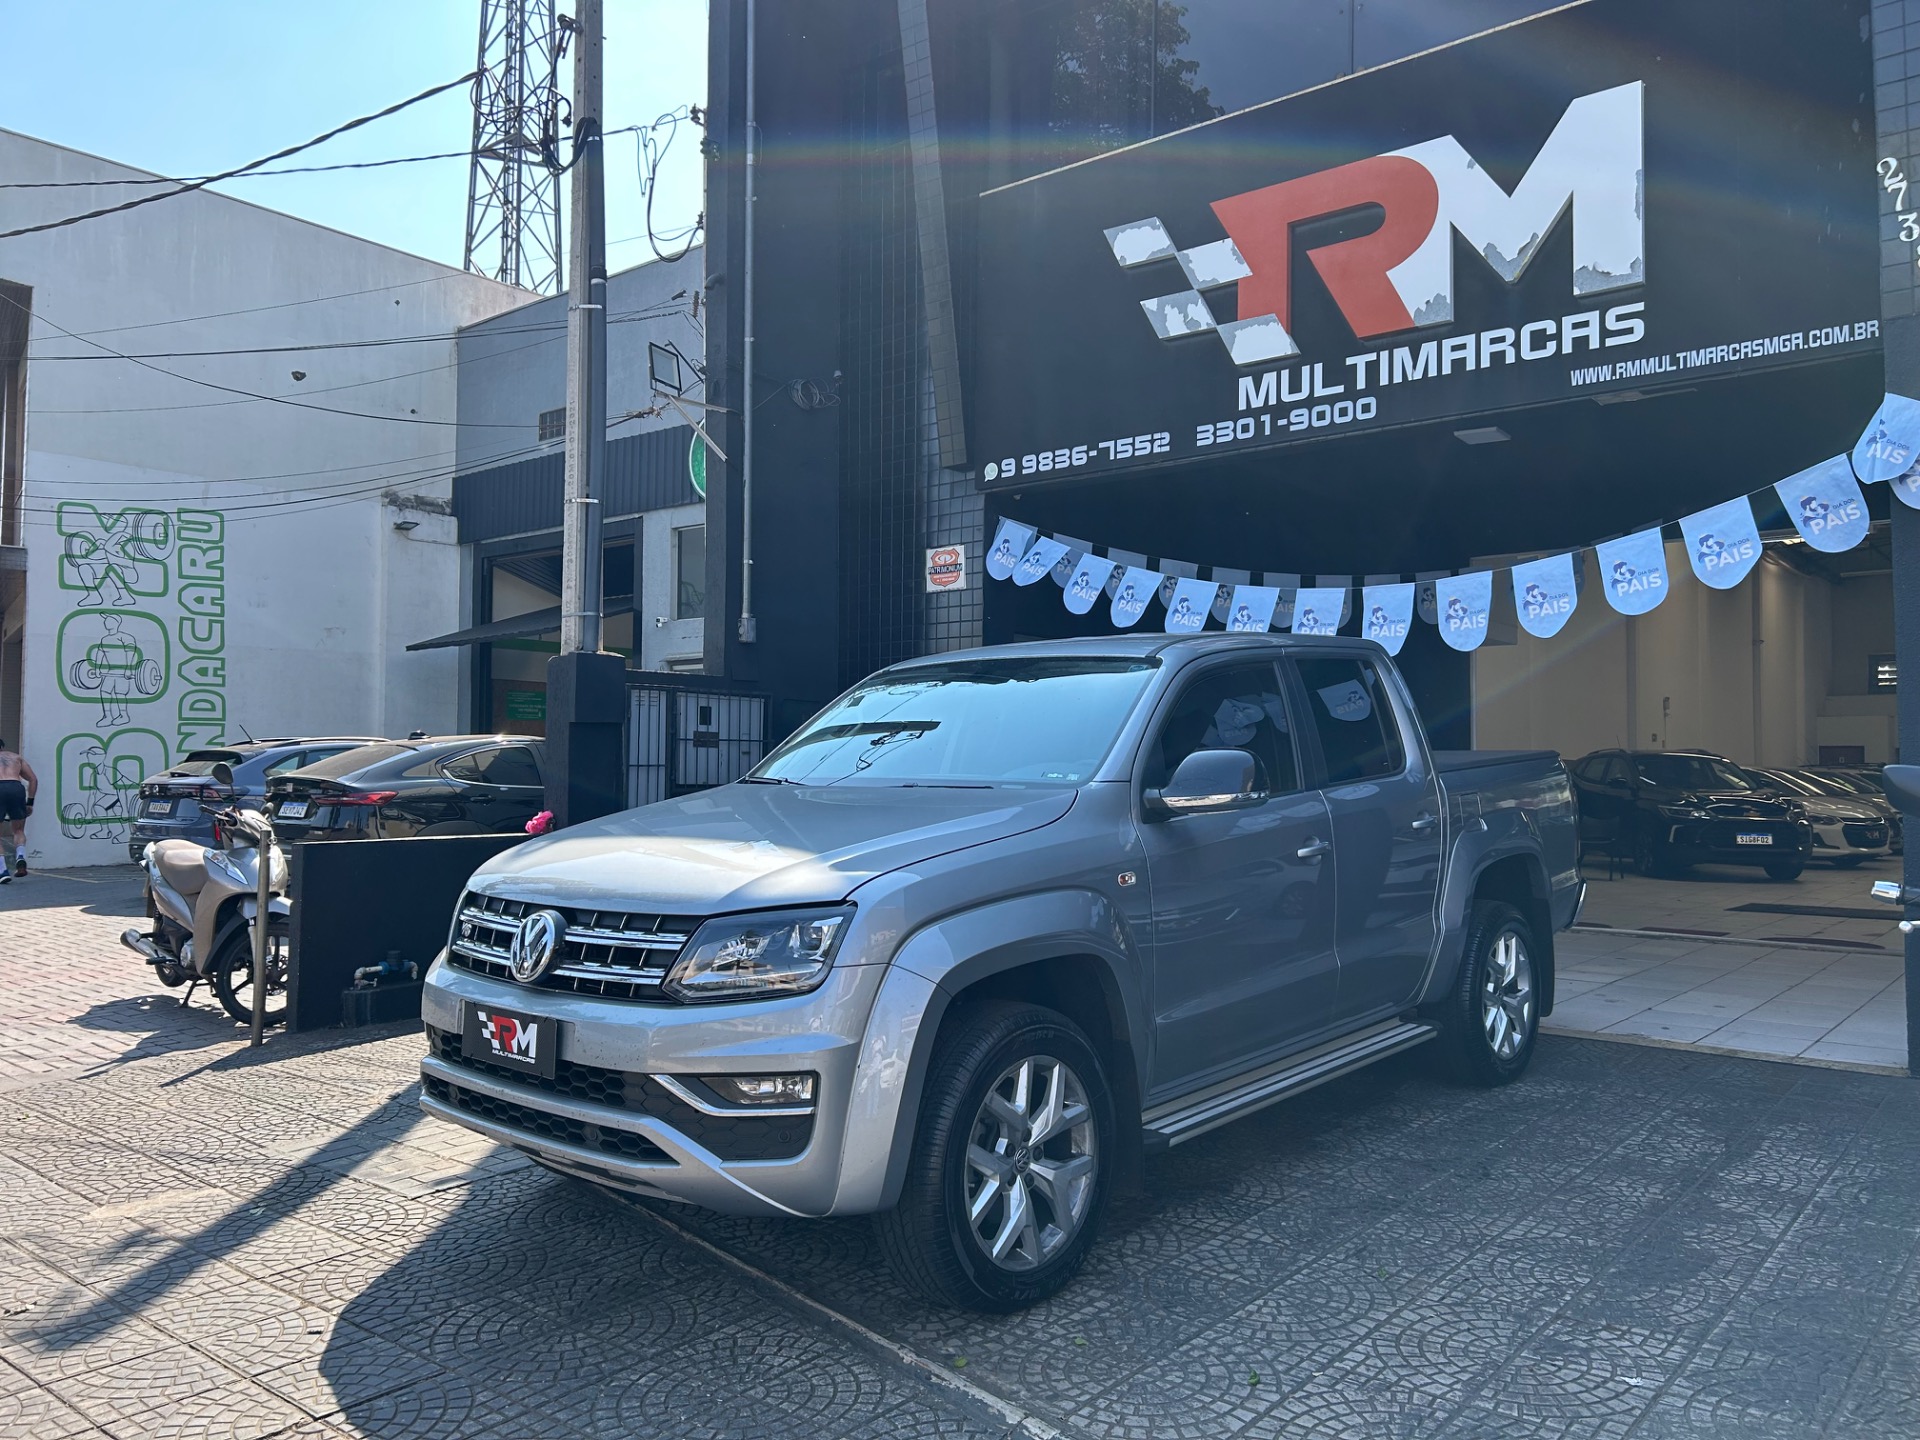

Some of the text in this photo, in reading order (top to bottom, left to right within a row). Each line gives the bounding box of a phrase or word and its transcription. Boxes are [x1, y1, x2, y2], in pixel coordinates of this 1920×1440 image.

[1210, 80, 1645, 340] RM
[1876, 157, 1920, 268] 273
[1238, 301, 1646, 411] MULTIMARCAS
[1570, 319, 1880, 387] WWW.RMMULTIMARCASMGA.COM.BR
[1000, 396, 1377, 478] 9 9836-7552 3301-9000
[1866, 443, 1907, 464] AIS
[1809, 501, 1861, 535] PAIS
[1703, 542, 1754, 571] PAIS
[1071, 584, 1099, 602] PAIS
[1616, 572, 1663, 597] PAIS
[1117, 600, 1143, 614] PAIS
[1172, 613, 1202, 628] PAIS
[1528, 598, 1571, 619] PAIS
[1370, 623, 1406, 638] PAIS
[1450, 614, 1487, 632] PAIS
[176, 508, 227, 766] NDACARU
[491, 1015, 538, 1058] RM
[491, 1048, 536, 1065] MULTIMARCAS
